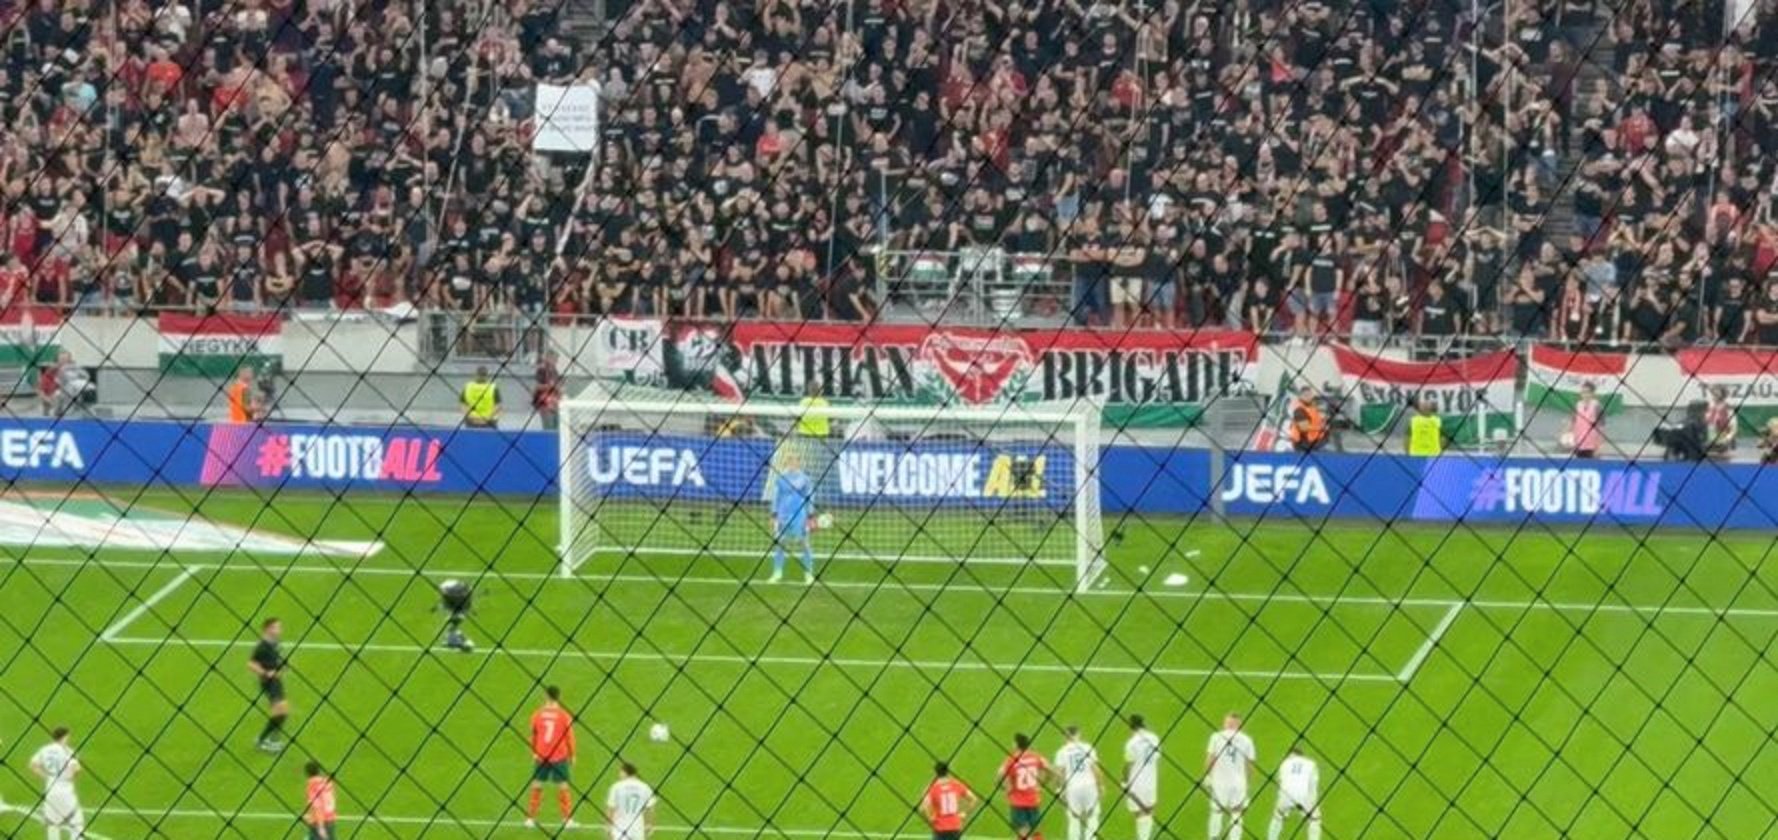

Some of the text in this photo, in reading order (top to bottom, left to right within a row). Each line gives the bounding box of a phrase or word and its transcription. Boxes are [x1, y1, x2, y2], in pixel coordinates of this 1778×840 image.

[1042, 350, 1244, 403] BRIGADE
[256, 433, 442, 481] #FOOTBALL
[588, 447, 705, 487] UEFA
[838, 450, 981, 496] WELCOME
[1470, 467, 1664, 515] #FOOTBALL
[544, 719, 555, 743] 7
